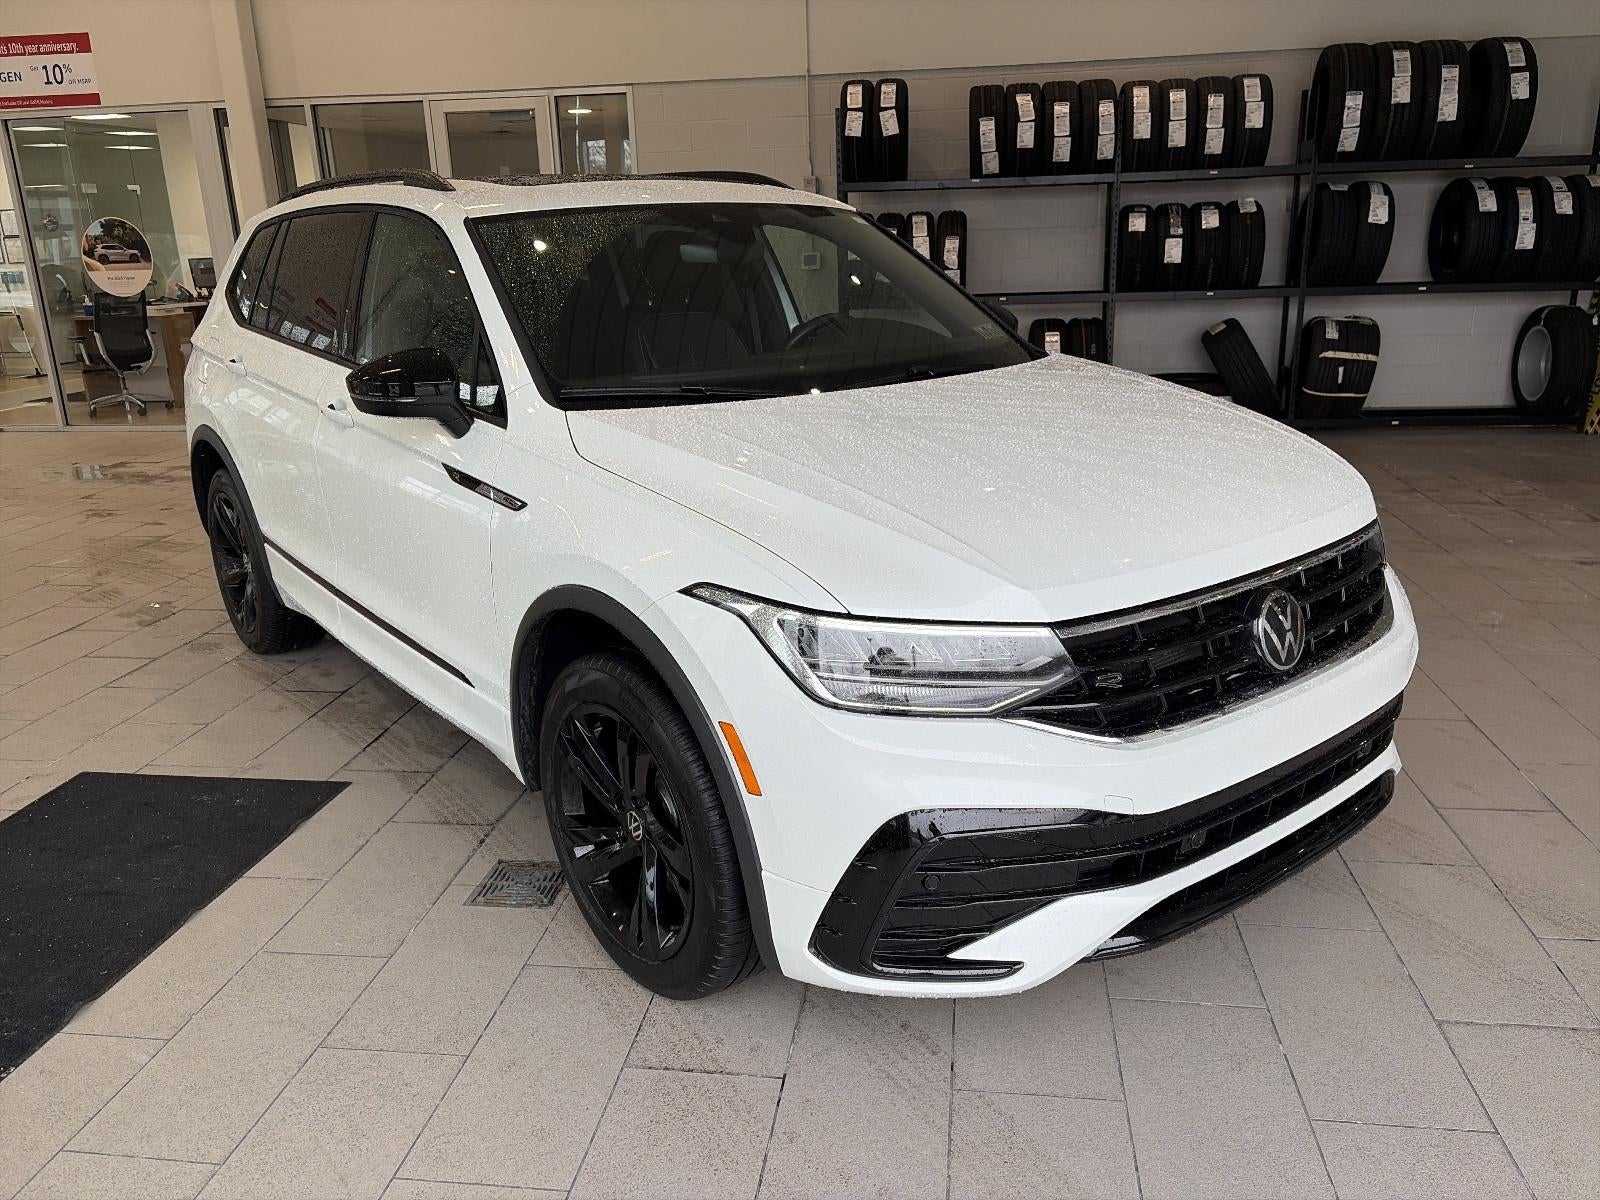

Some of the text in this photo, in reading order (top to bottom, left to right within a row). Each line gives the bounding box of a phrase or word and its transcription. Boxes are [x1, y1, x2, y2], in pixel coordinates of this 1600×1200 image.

[8, 42, 24, 54] 10th
[24, 43, 39, 56] year
[39, 41, 79, 54] anniversary.
[0, 71, 22, 82] GEN
[42, 63, 73, 86] 10%
